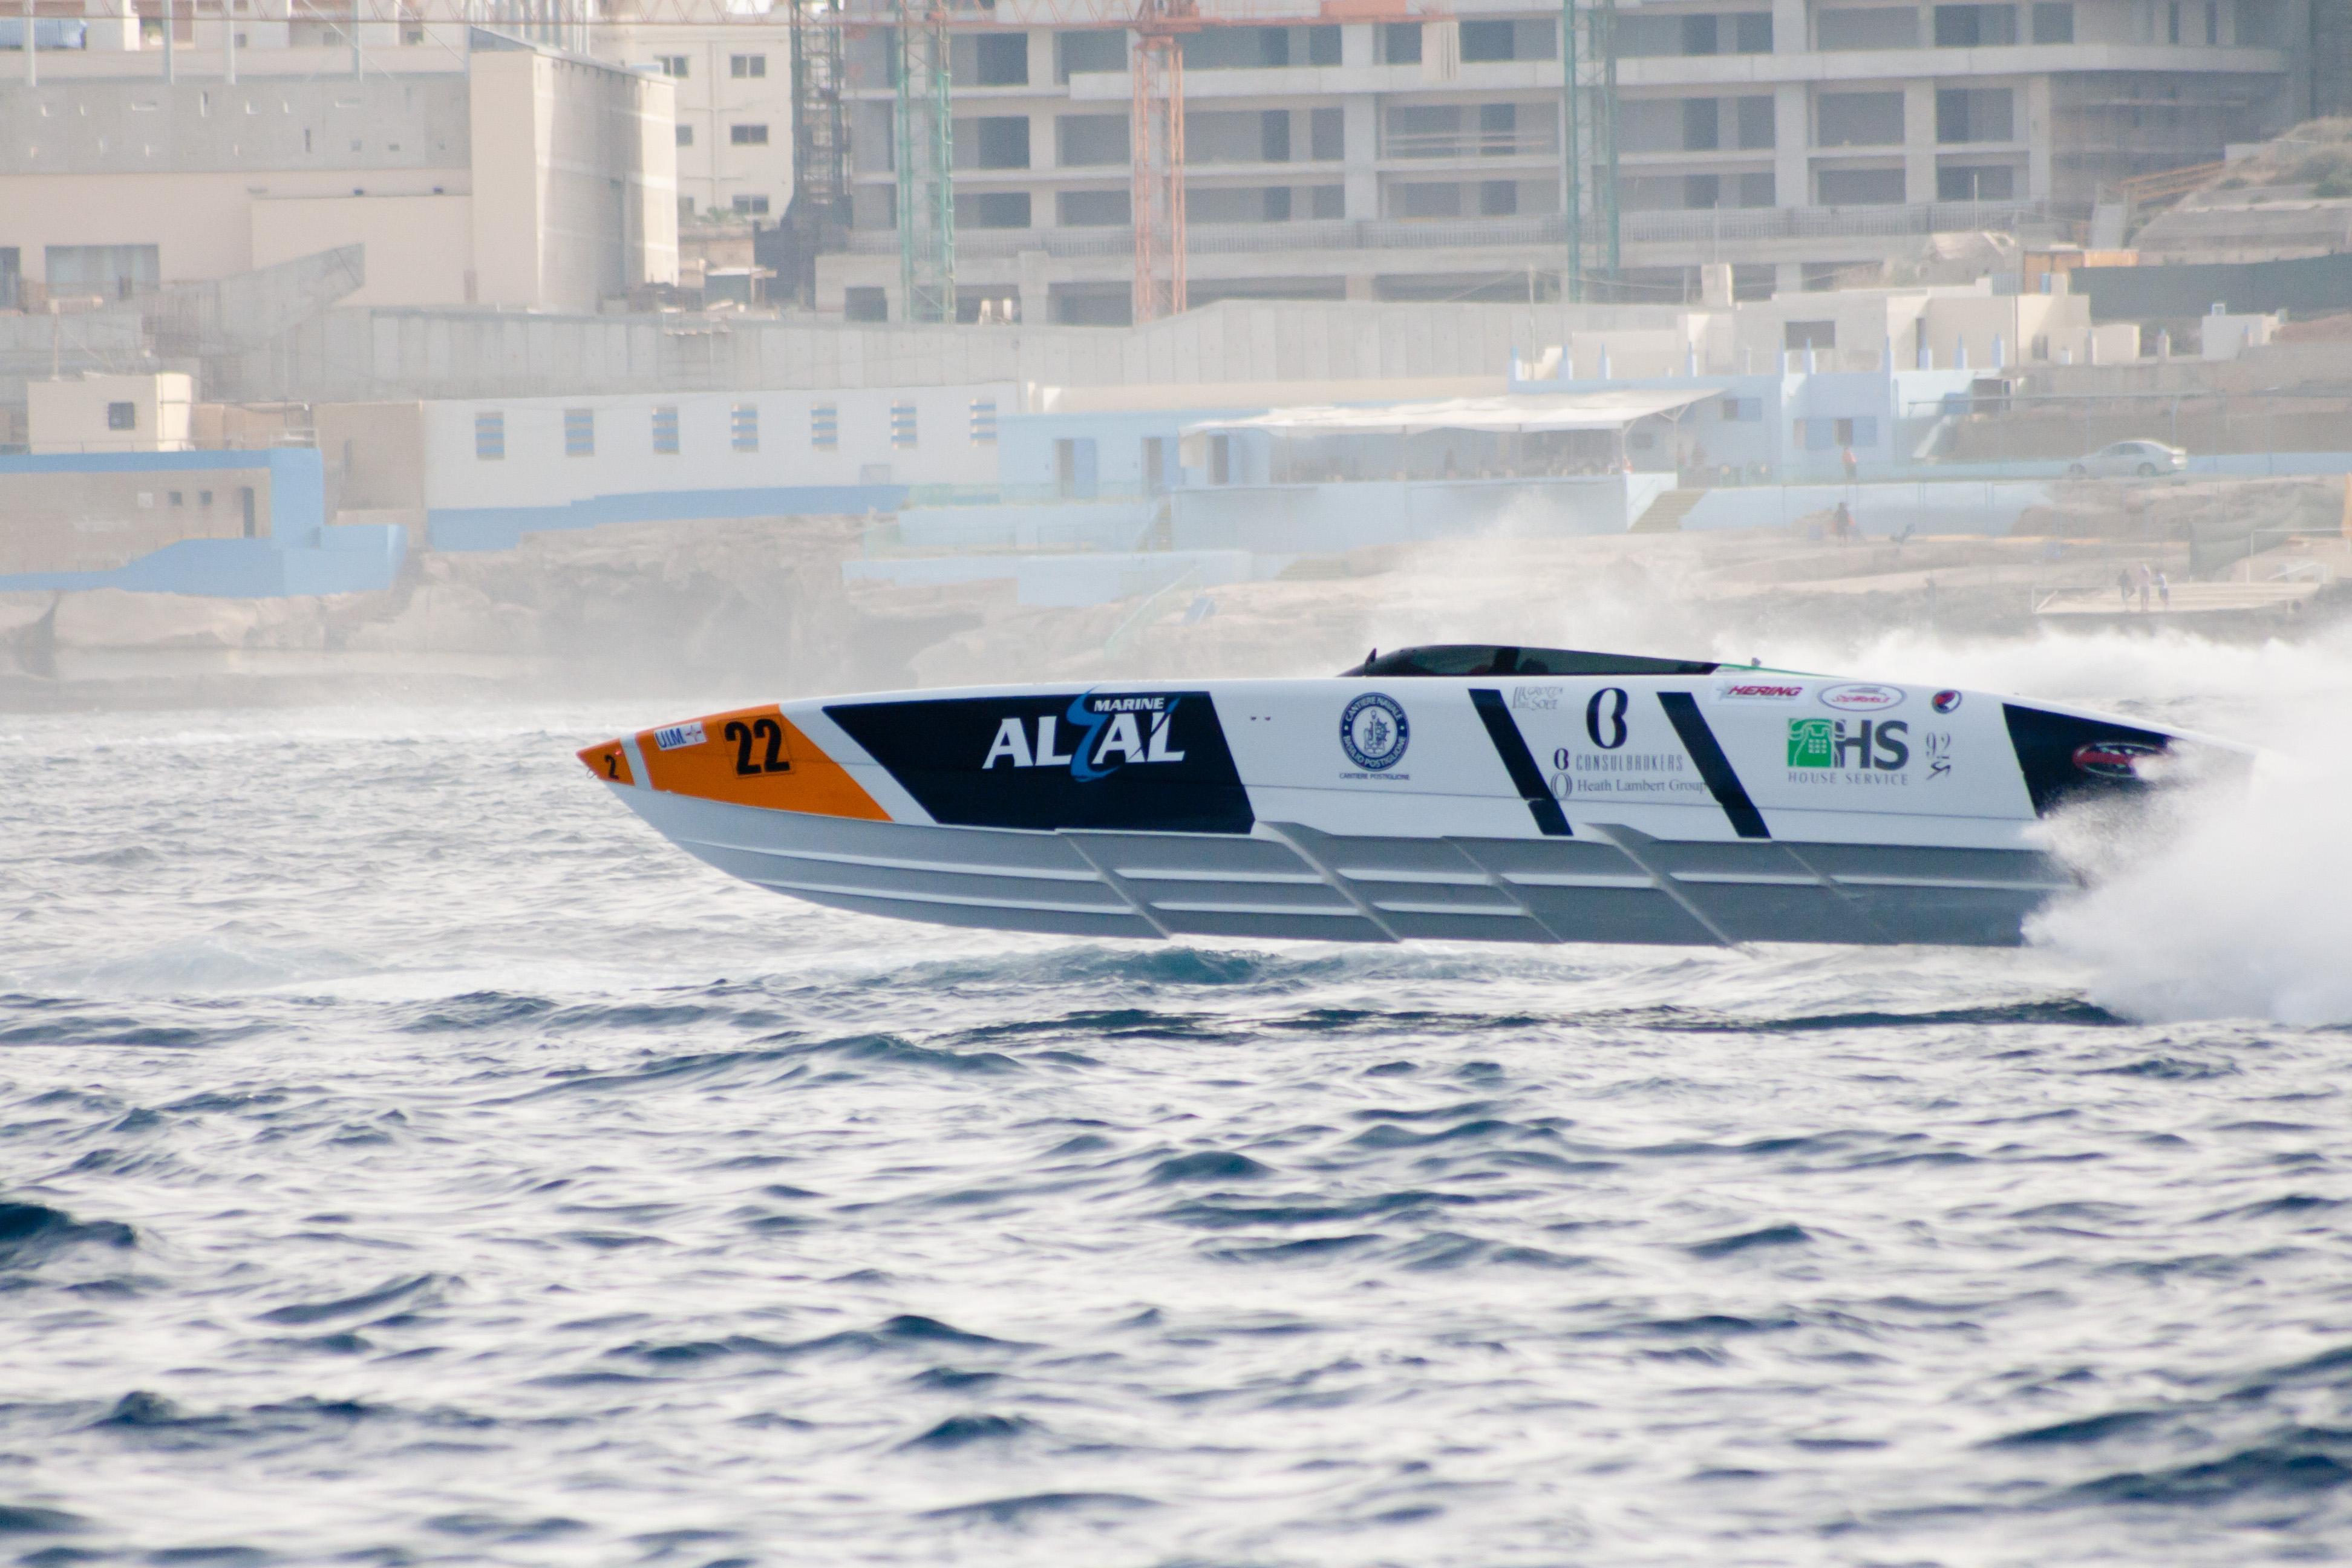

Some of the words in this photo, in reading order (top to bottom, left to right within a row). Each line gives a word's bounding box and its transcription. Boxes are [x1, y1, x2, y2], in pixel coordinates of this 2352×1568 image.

[1727, 685, 1803, 696] HERING
[1094, 696, 1165, 712] MARINE
[724, 718, 791, 775] 22
[1834, 719, 1910, 771] HS
[605, 754, 619, 780] 2
[1576, 754, 1684, 771] CONSULBROKERS
[1788, 772, 1836, 784] HOUSE
[1845, 773, 1908, 785] SERVICE
[1577, 779, 1612, 792] Heath
[1616, 779, 1665, 792] Lambert
[1668, 779, 1707, 795] Group
